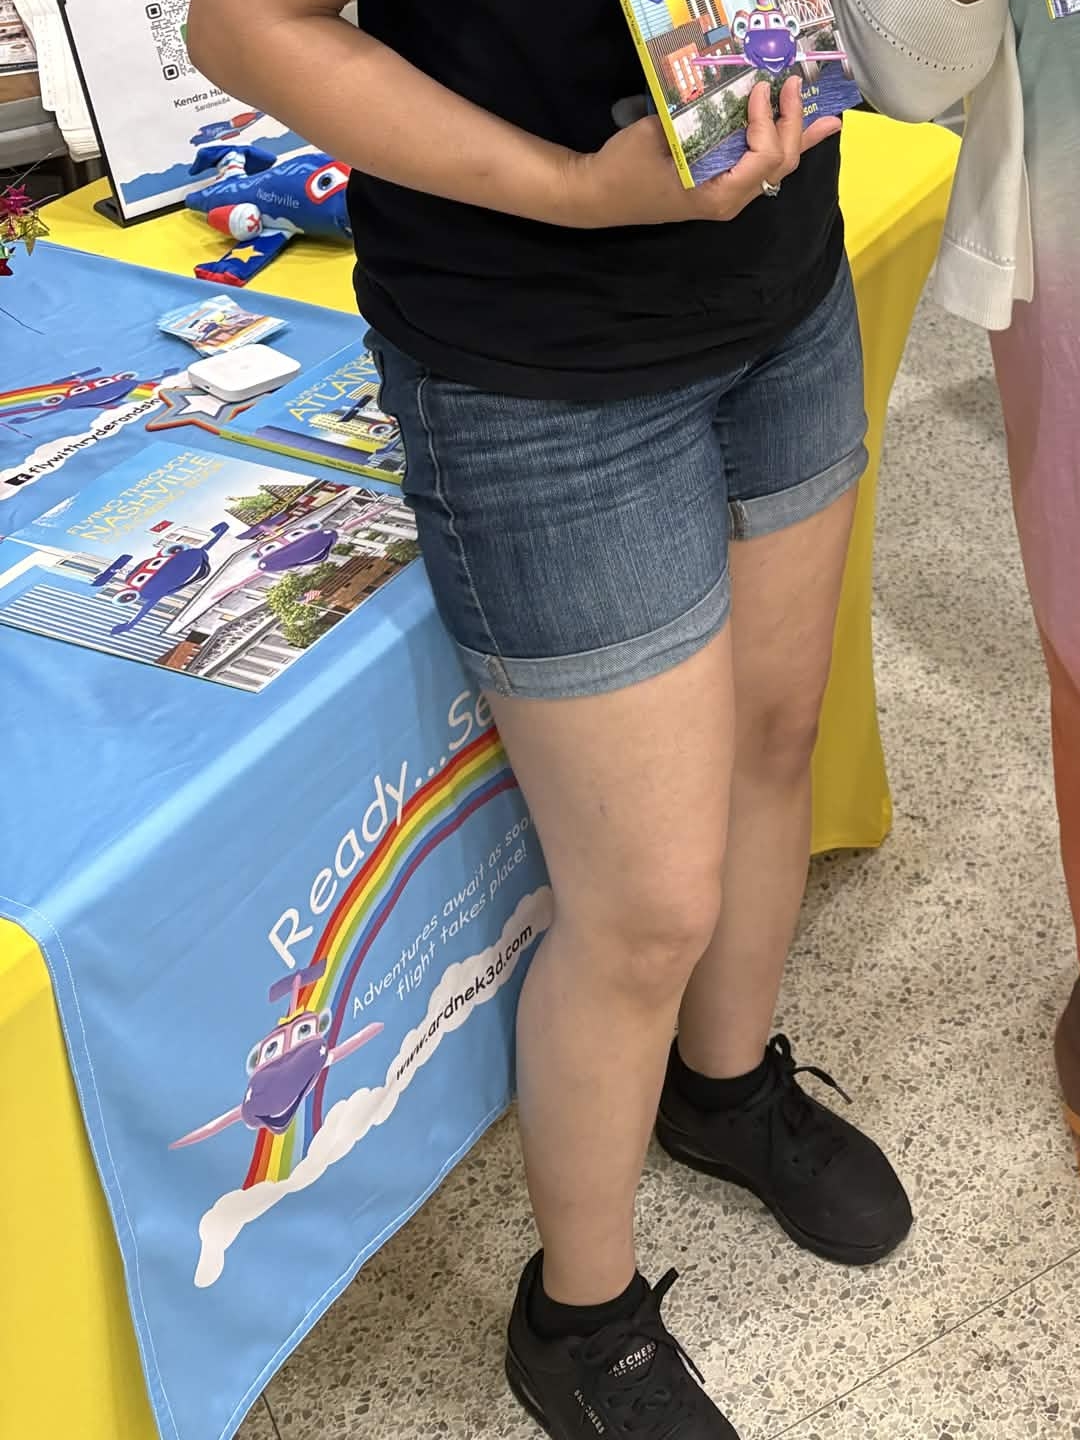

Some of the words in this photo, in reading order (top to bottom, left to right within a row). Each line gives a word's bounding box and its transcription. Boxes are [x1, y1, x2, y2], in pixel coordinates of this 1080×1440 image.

[173, 92, 208, 108] Kendra
[256, 187, 300, 209] Nashville
[66, 498, 123, 536] FLYING
[119, 451, 194, 498] THROUGH
[79, 455, 215, 540] NASHVILLE
[352, 913, 438, 1019] Adventures
[442, 861, 484, 918] await
[488, 848, 502, 867] as
[396, 942, 437, 1001] flight
[440, 896, 487, 945] takes
[489, 839, 528, 901] place!
[396, 924, 533, 1081] www.ardnek3d.com
